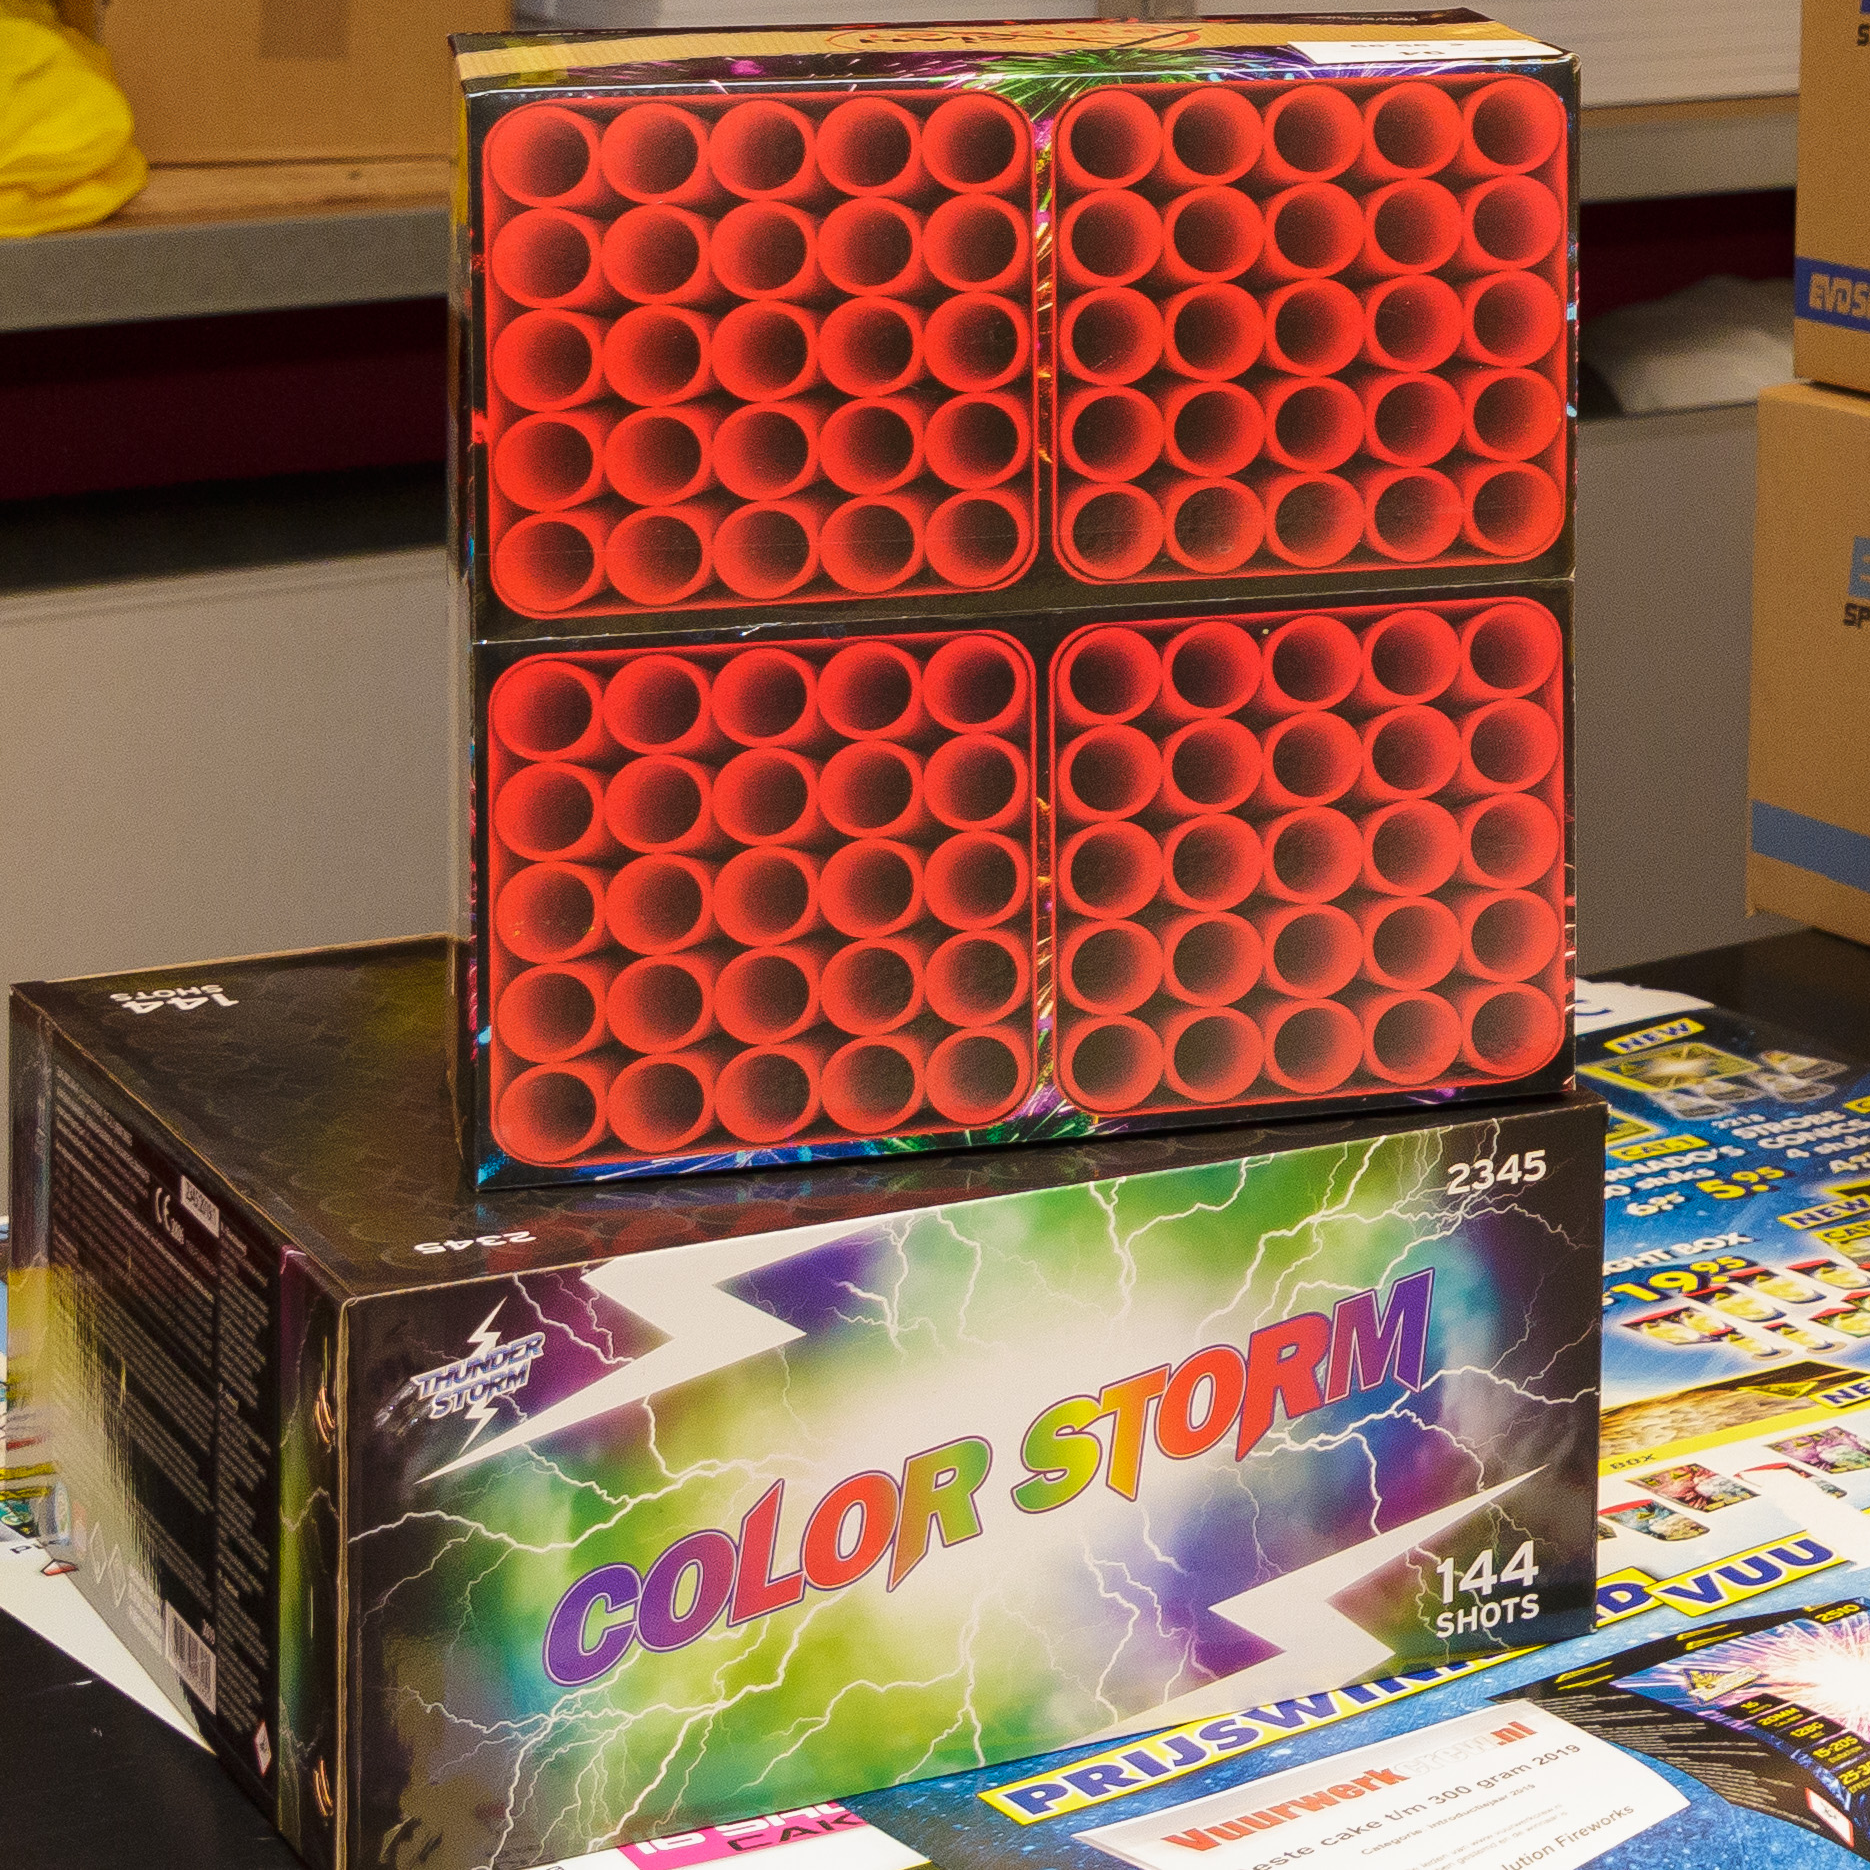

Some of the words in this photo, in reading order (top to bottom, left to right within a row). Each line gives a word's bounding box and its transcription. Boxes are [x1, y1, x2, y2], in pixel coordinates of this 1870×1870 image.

[121, 993, 239, 1015] 144
[1616, 1021, 1691, 1052] NEW
[1447, 1149, 1548, 1197] 2345
[1634, 1167, 1716, 1189] stuks
[1695, 1165, 1790, 1201] 5.95
[413, 1231, 537, 1255] 2345
[1671, 1231, 1755, 1256] BOX
[1610, 1255, 1748, 1302] 19.95
[412, 1332, 546, 1401] THUNDER
[428, 1357, 533, 1421] STORM
[543, 1435, 993, 1689] COLOR
[1011, 1267, 1436, 1514] STORM
[1608, 1451, 1657, 1471] BOX
[1436, 1540, 1541, 1607] 144
[1436, 1592, 1540, 1638] SHOTS
[1815, 1603, 1861, 1623] 2510
[1812, 1735, 1859, 1762] 15-20S
[1161, 1721, 1538, 1852] Vuurwerkcrew.nl
[1321, 1818, 1382, 1851] cake
[1385, 1800, 1426, 1824] t/m
[1433, 1785, 1473, 1808] 300
[1475, 1763, 1536, 1791] gram
[1536, 1744, 1582, 1767] 2019
[1553, 1804, 1635, 1848] Fireworks
